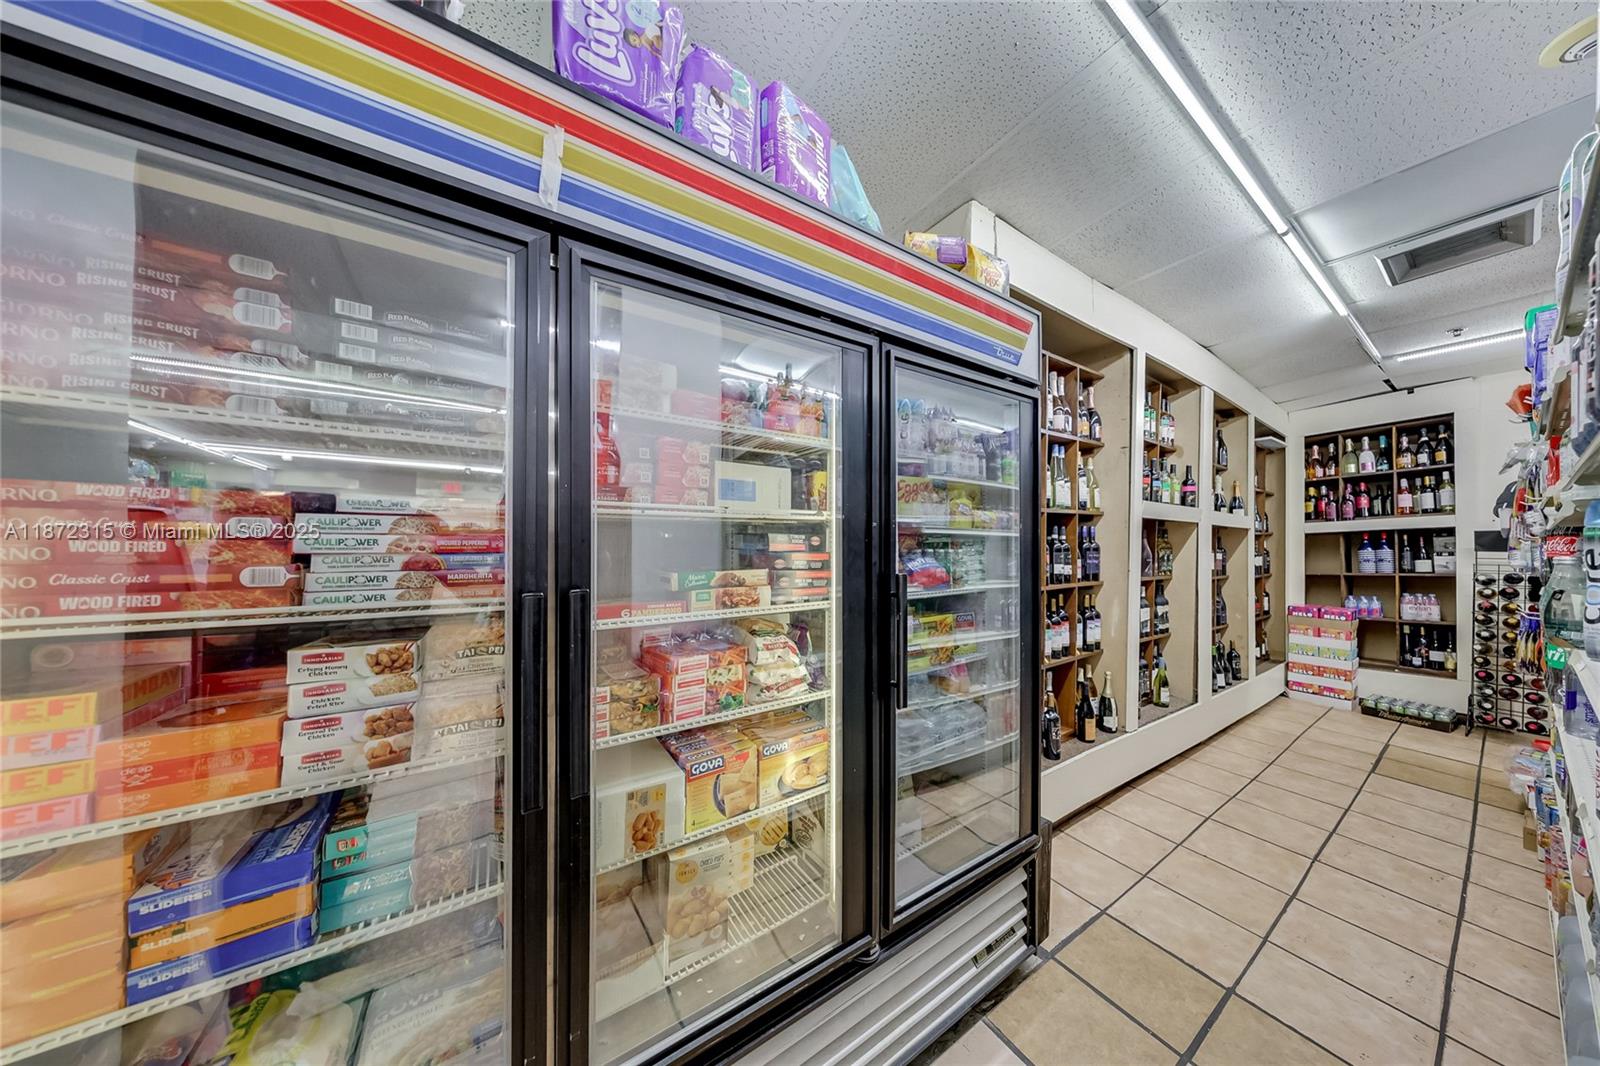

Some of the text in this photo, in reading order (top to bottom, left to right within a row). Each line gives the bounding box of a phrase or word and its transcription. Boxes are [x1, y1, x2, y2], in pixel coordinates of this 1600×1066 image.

[85, 257, 133, 272] RISING
[138, 266, 182, 286] CRUST
[76, 272, 129, 289] RISING
[132, 283, 178, 302] CRUST
[104, 311, 153, 327] RISING
[157, 321, 201, 340] CRUST
[71, 326, 123, 342] RISING
[131, 336, 175, 355] CRUST
[61, 374, 116, 389] RISING
[121, 381, 168, 400] CRUST
[75, 484, 125, 499] WOOD
[129, 486, 171, 499] FIRED
[68, 541, 120, 554] WOOD
[128, 541, 167, 554] FIRED
[303, 538, 380, 547] CAULIPOWER
[321, 555, 397, 565] CAULIPOWER
[49, 574, 106, 586] Classic
[110, 573, 151, 585] Crust
[315, 575, 389, 585] CAULIPOWER
[447, 572, 493, 580] MARGHERITA
[59, 597, 114, 611] WOOD
[117, 595, 162, 608] FIRED
[312, 594, 387, 604] CAULIPOWER
[457, 648, 475, 659] TAI
[308, 670, 338, 678] Chicken
[310, 696, 341, 705] Chicken
[451, 722, 469, 734] TAI
[307, 732, 335, 741] Chicken
[763, 742, 789, 756] GOYA
[308, 765, 336, 774] Chicken
[691, 757, 723, 775] GOYA
